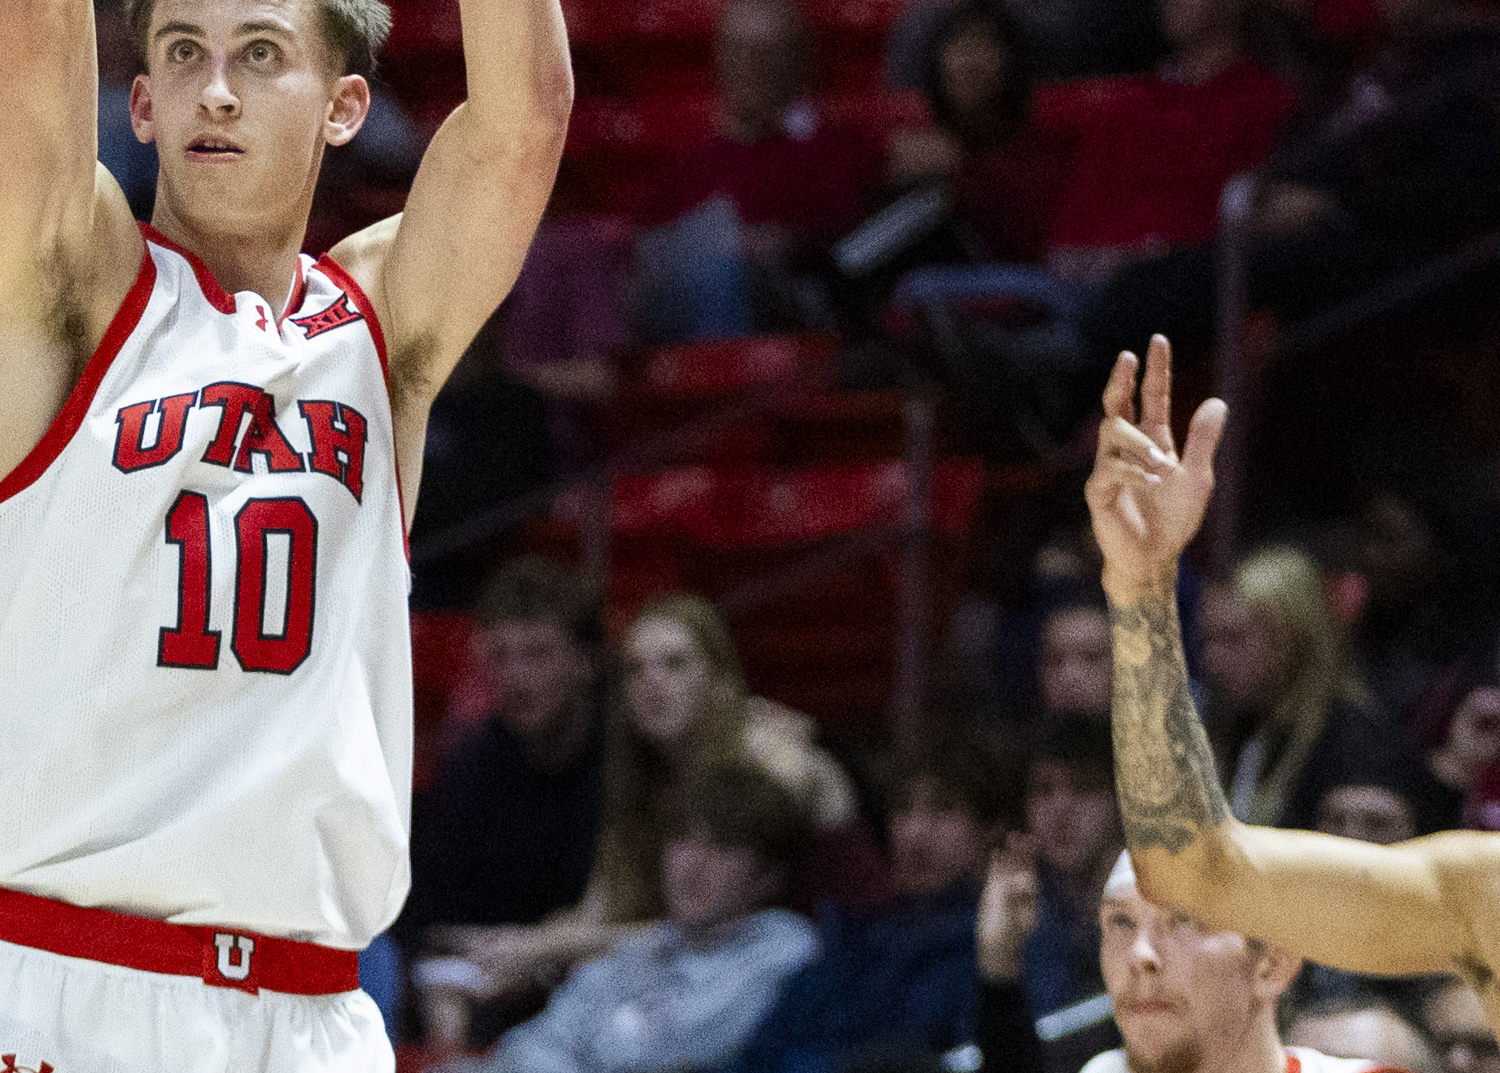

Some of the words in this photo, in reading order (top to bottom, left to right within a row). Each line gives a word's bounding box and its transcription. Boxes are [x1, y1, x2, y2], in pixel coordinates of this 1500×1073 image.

[112, 381, 368, 506] UTAH
[157, 489, 318, 675] 10
[213, 933, 255, 981] U
